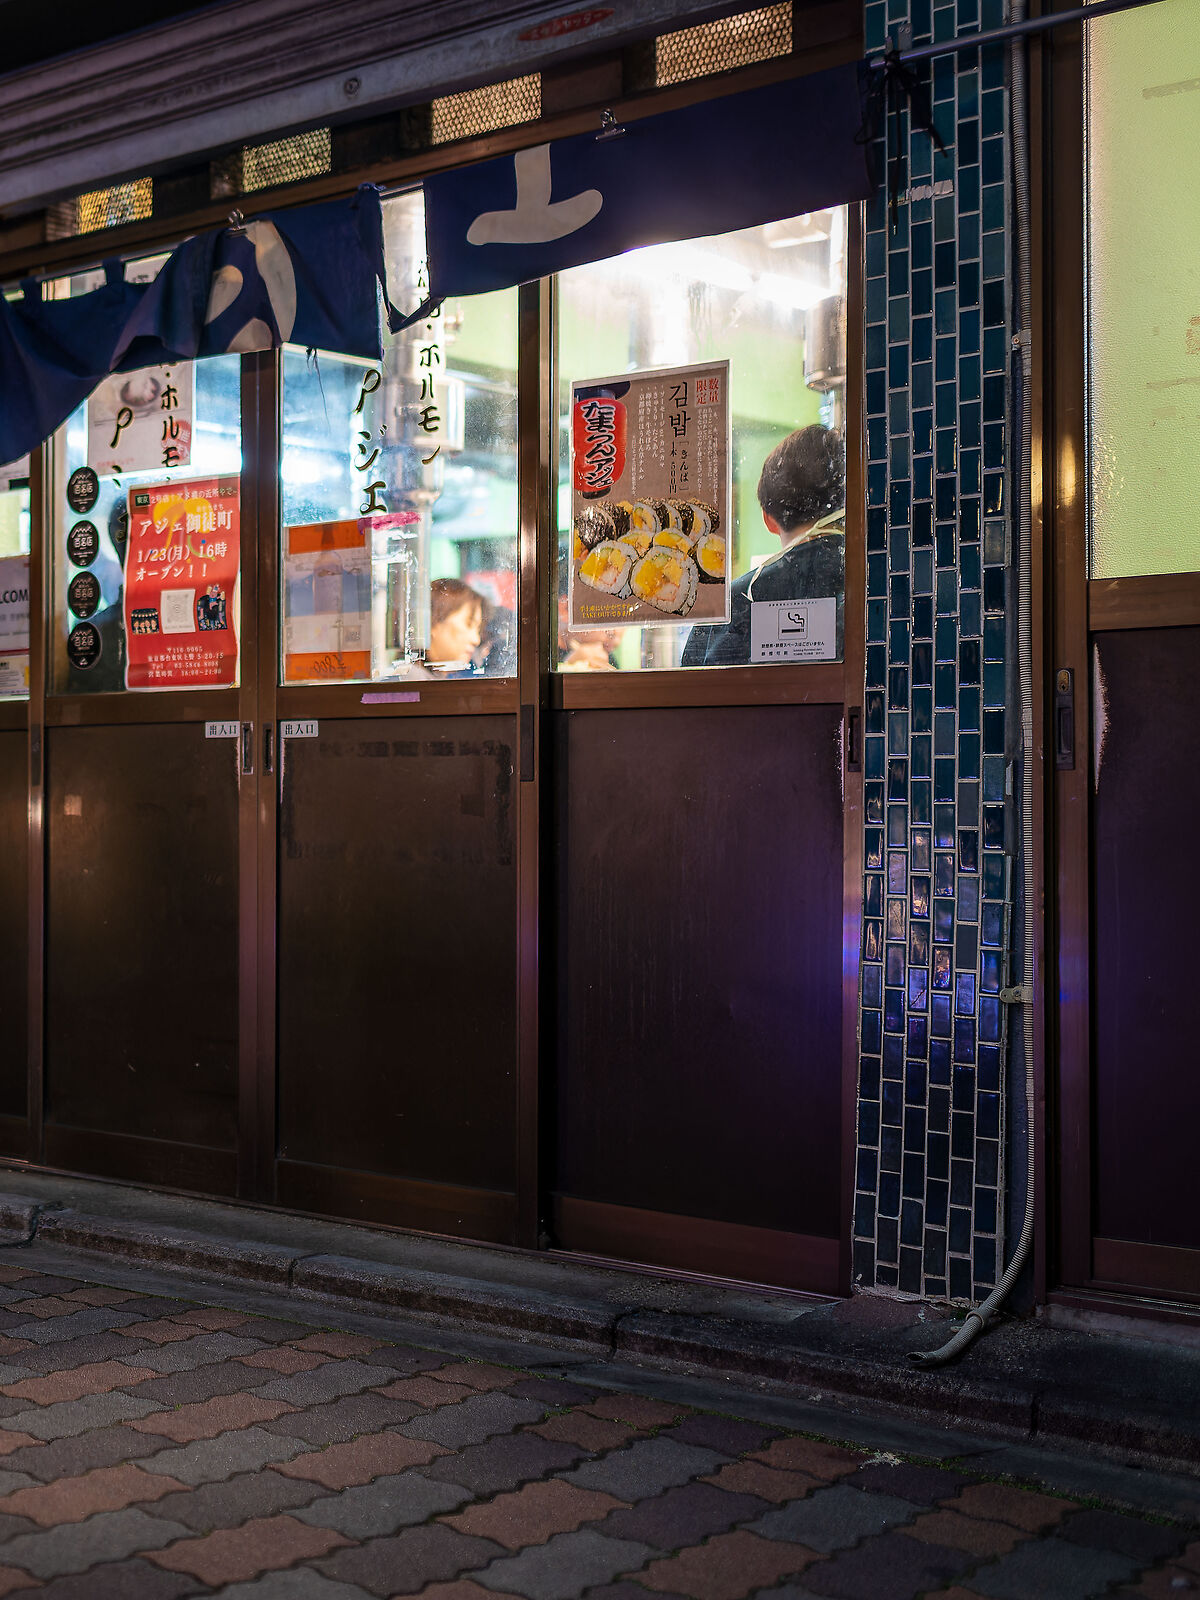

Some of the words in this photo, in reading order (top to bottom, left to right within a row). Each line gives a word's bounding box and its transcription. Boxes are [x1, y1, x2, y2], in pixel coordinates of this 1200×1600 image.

[696, 379, 707, 405] 限定
[668, 381, 691, 438] 김밥
[199, 542, 228, 558] 16時
[210, 725, 237, 736] 出入口
[285, 723, 314, 735] 出入口
